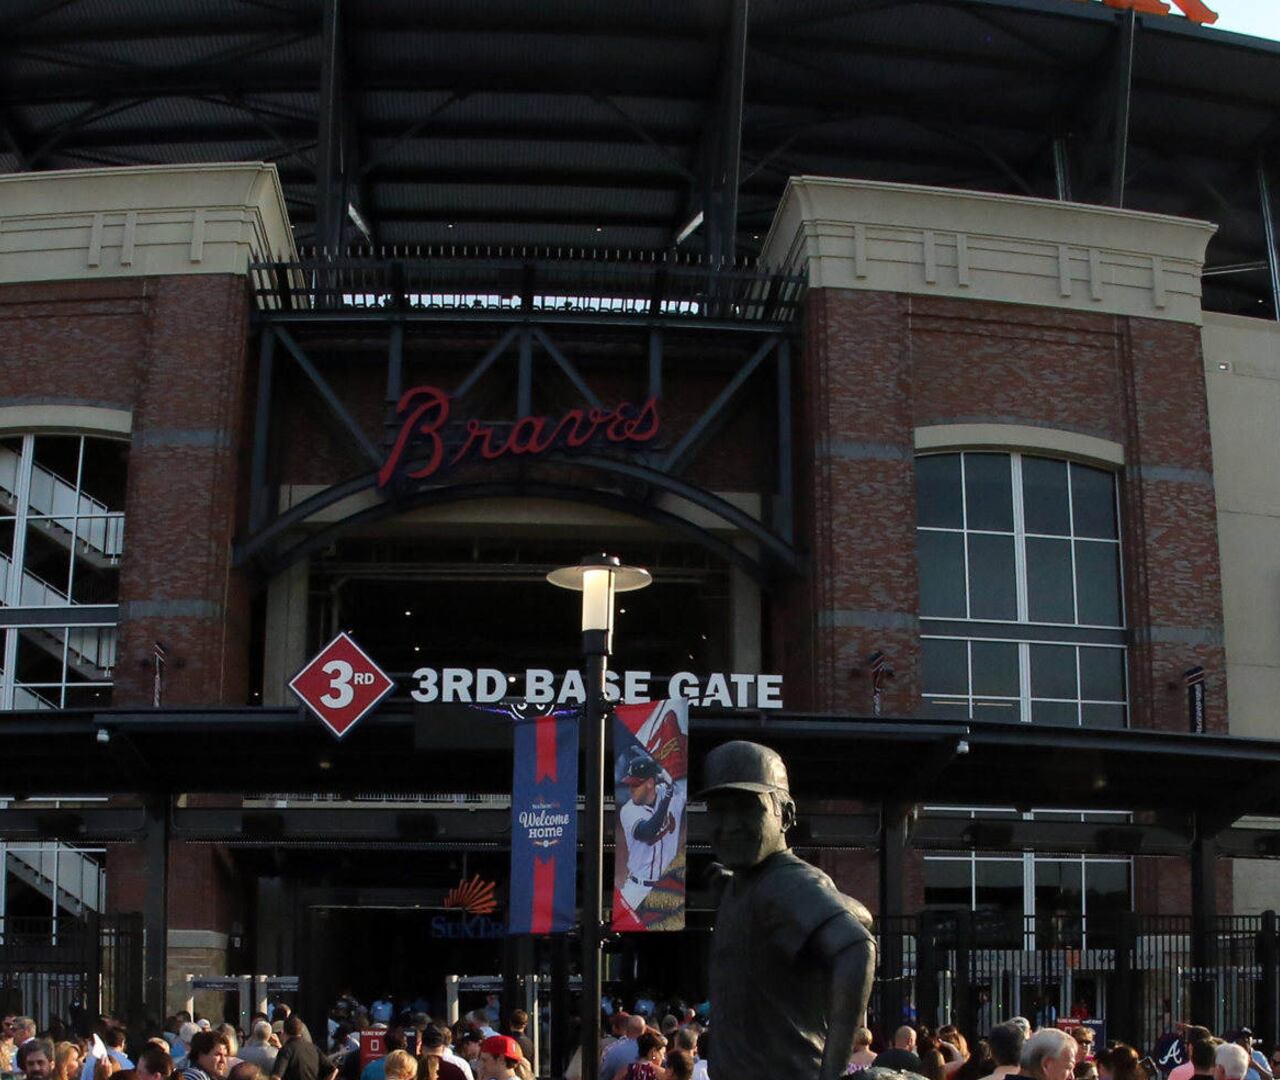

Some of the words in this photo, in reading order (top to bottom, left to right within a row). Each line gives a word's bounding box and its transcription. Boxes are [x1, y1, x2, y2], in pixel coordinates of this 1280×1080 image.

[378, 384, 661, 488] Braves
[410, 667, 508, 703] 3RD
[524, 668, 651, 704] BASE
[668, 671, 784, 709] GATE
[519, 809, 570, 828] Welcome
